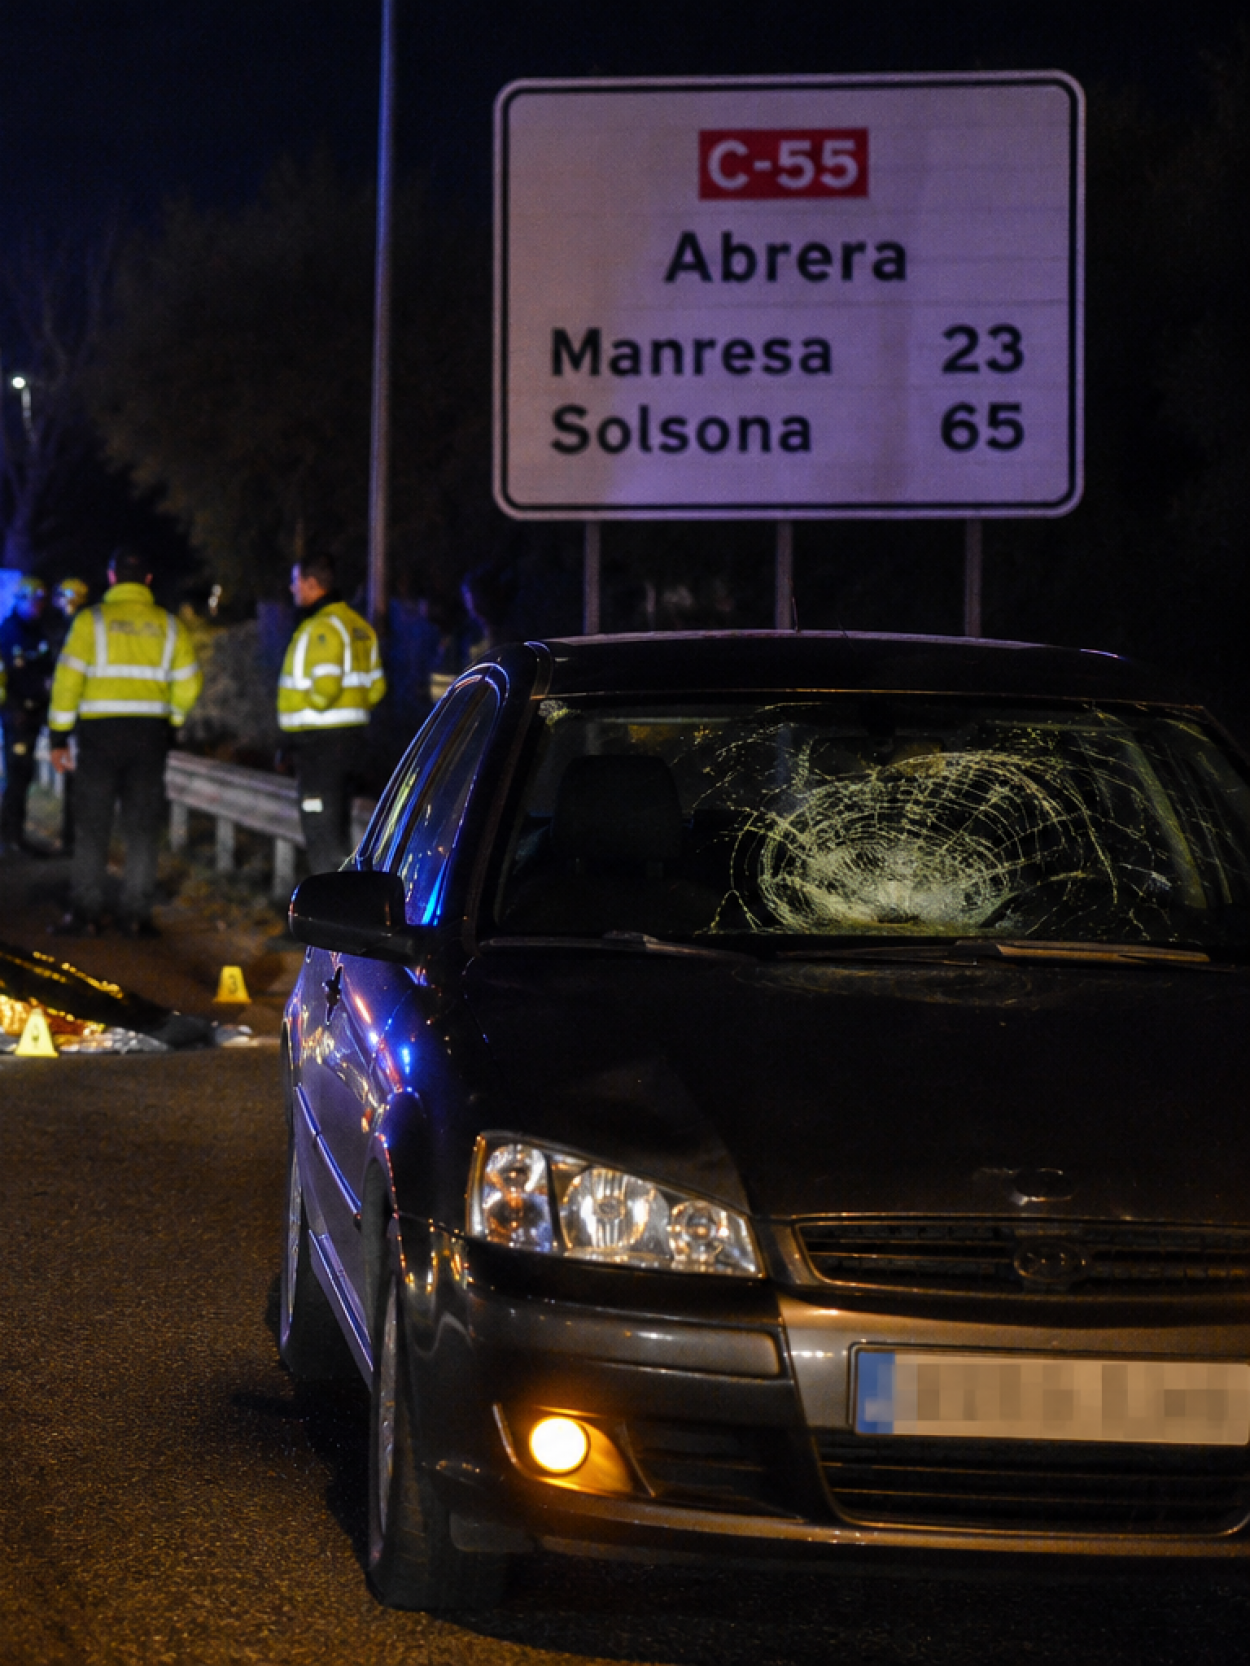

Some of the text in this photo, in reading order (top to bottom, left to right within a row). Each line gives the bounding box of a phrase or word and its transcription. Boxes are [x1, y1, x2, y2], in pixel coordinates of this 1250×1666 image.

[707, 139, 859, 190] C-55
[664, 231, 908, 283] Abrera
[551, 323, 1025, 377] Manresa 23
[551, 401, 1025, 455] Solsona 65
